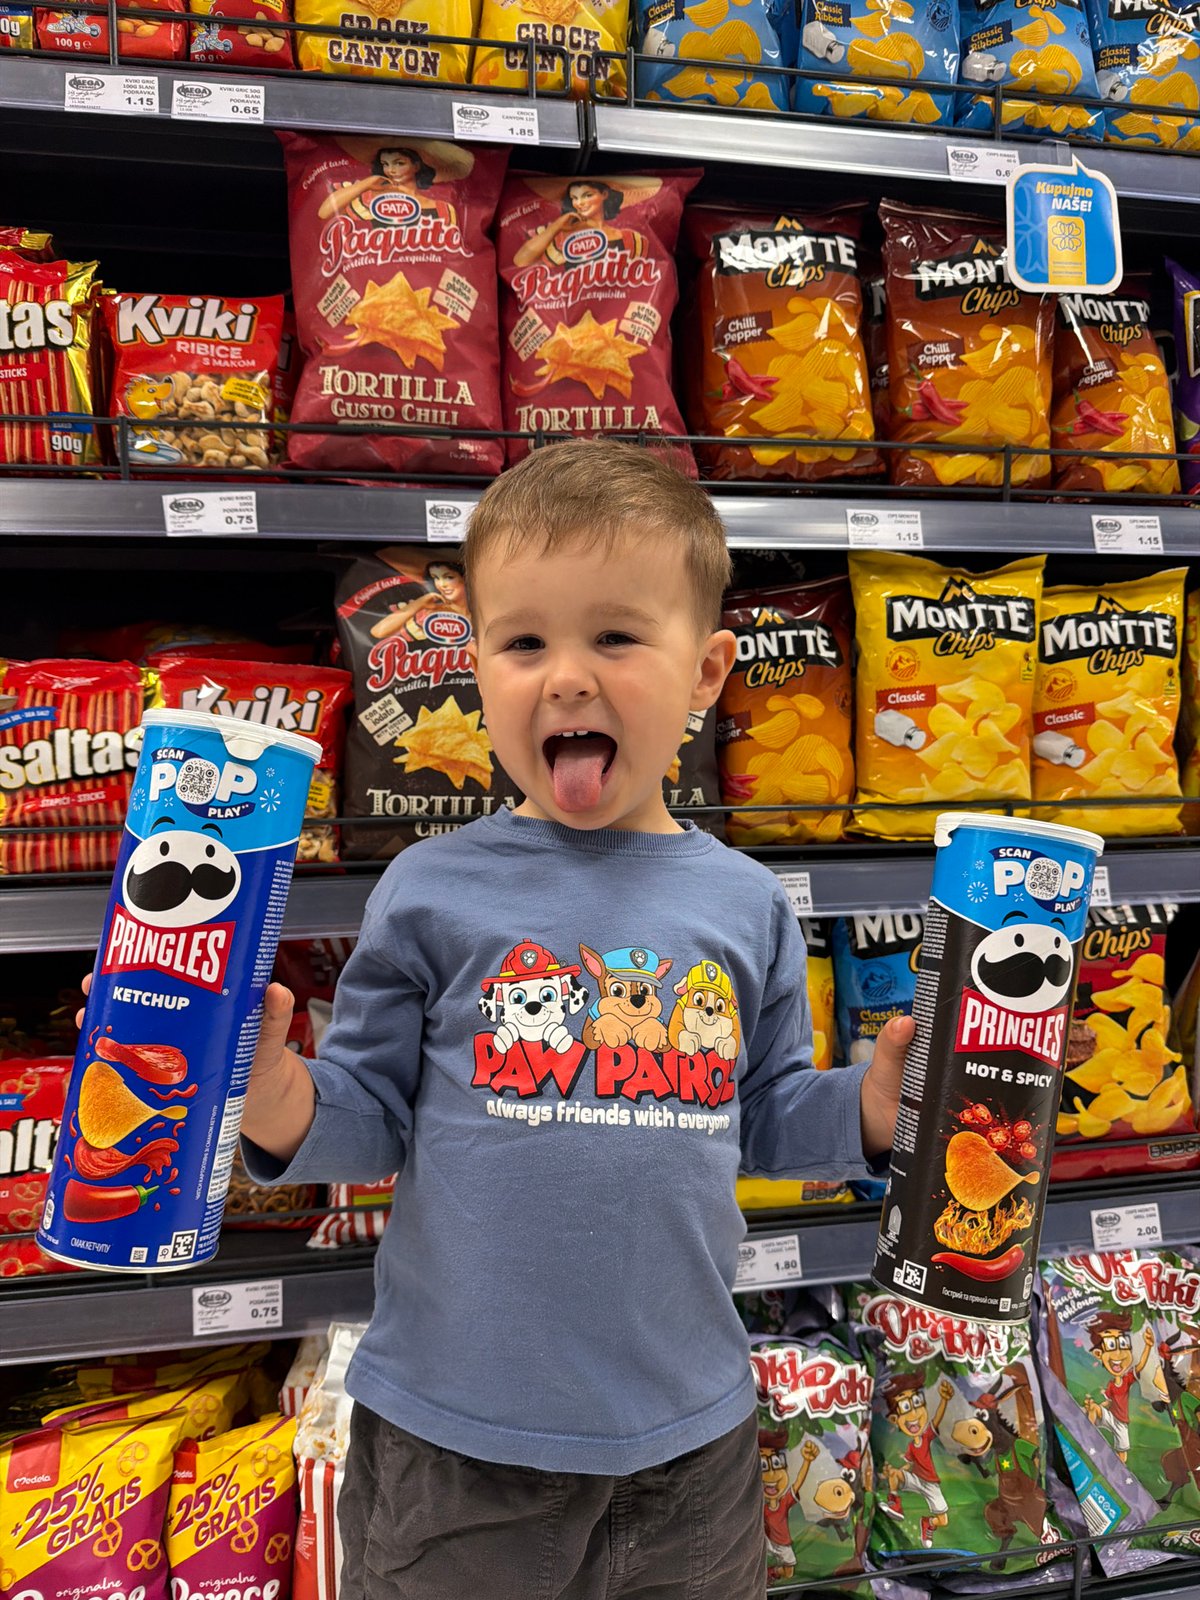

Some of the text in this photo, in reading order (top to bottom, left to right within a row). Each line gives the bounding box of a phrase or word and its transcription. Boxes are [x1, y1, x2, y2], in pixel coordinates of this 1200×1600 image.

[815, 1, 843, 14] Classic
[815, 12, 843, 25] Ribbed
[55, 38, 72, 47] 100
[516, 22, 602, 51] CROCK
[969, 34, 1004, 51] Ribbed
[970, 25, 1003, 43] Classic
[327, 40, 441, 77] CANYON
[1100, 46, 1130, 58] Classic
[1098, 55, 1130, 69] Ribbed
[125, 97, 154, 106] 1.15
[231, 105, 259, 114] 0.65
[508, 127, 534, 137] 1.85
[302, 158, 349, 190] Original taste
[1036, 181, 1094, 198] Kupujmo
[380, 202, 411, 216] PATA
[1051, 196, 1092, 212] NAŠE!
[320, 215, 474, 277] Paquita
[572, 239, 598, 254] PATA
[511, 247, 661, 313] Paquita
[767, 263, 825, 290] Chips
[961, 286, 1020, 315] Chips
[117, 294, 260, 346] Kviki
[728, 317, 757, 332] Chilli
[724, 326, 763, 344] Pepper
[1100, 323, 1143, 345] Chips
[176, 340, 243, 360] RIBICE
[924, 343, 950, 355] Chilli
[211, 357, 256, 368] MAKOM
[918, 352, 956, 368] Pepper
[0, 368, 27, 379] STICKS
[319, 365, 475, 406] TORTILLA
[331, 398, 459, 426] GUSTO CHILI
[515, 404, 662, 433] TORTILLA
[51, 434, 83, 454] 90g
[225, 515, 253, 525] 0.75
[896, 532, 919, 541] 1.15
[1138, 537, 1159, 545] 1.15
[354, 576, 401, 606] Original taste
[892, 600, 1030, 634] MONTTE
[433, 620, 461, 634] PATA
[737, 627, 838, 663] ONTTE
[934, 631, 996, 660] Chips
[1043, 617, 1174, 657] MONTTE
[367, 635, 476, 692] Paqu
[1089, 646, 1145, 674] Chips
[746, 658, 807, 687] Chips
[394, 680, 428, 696] tortilla
[887, 690, 926, 705] Classic
[364, 699, 392, 721] con sale
[372, 708, 395, 726] iodato
[1044, 709, 1084, 726] Classic
[156, 749, 185, 760] SCAN
[999, 848, 1031, 859] SCAN
[106, 913, 227, 984] PRINGLES
[1084, 926, 1152, 960] Chips
[113, 986, 190, 1010] KETCHUP
[961, 997, 1065, 1062] PRINGLES
[471, 1031, 736, 1110] PAW PATROL
[965, 1062, 1053, 1088] HOT & SPICY
[486, 1099, 731, 1136] Always friends with everyone
[1137, 1226, 1158, 1236] 2.00
[775, 1259, 798, 1271] 1.80
[942, 1286, 963, 1299] Гострий
[1116, 1281, 1138, 1299] &
[251, 1307, 278, 1318] 0.75
[13, 1474, 51, 1488] Medela
[46, 1476, 141, 1557] GRATIS
[194, 1476, 276, 1548] GRATIS
[56, 1577, 123, 1598] originalne
[199, 1572, 258, 1591] originalne
